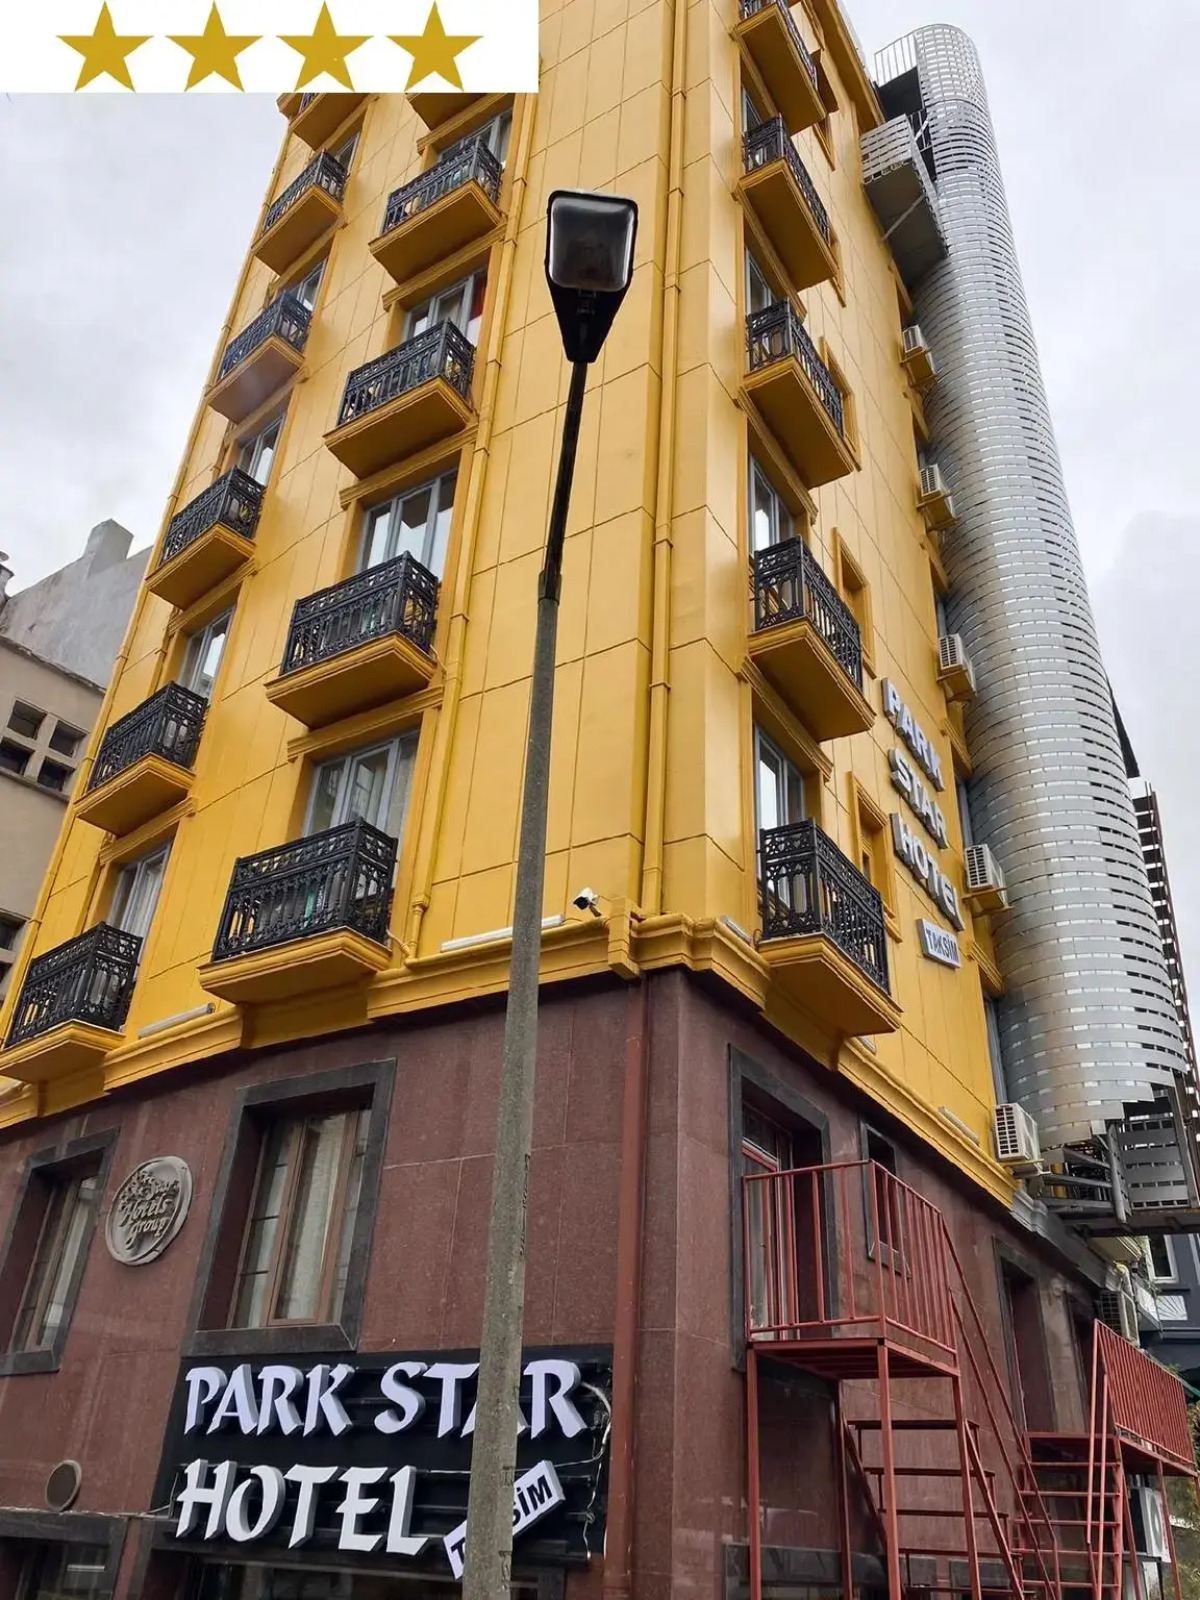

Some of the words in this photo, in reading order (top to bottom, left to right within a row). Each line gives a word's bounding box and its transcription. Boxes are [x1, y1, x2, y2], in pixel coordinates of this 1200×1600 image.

[881, 677, 945, 792] PARK
[888, 749, 948, 849] STAR
[889, 813, 965, 932] HOTEL
[119, 1193, 174, 1228] Hotels
[184, 1363, 355, 1437] PARK
[374, 1358, 592, 1440] STR
[176, 1458, 428, 1556] HOTEL
